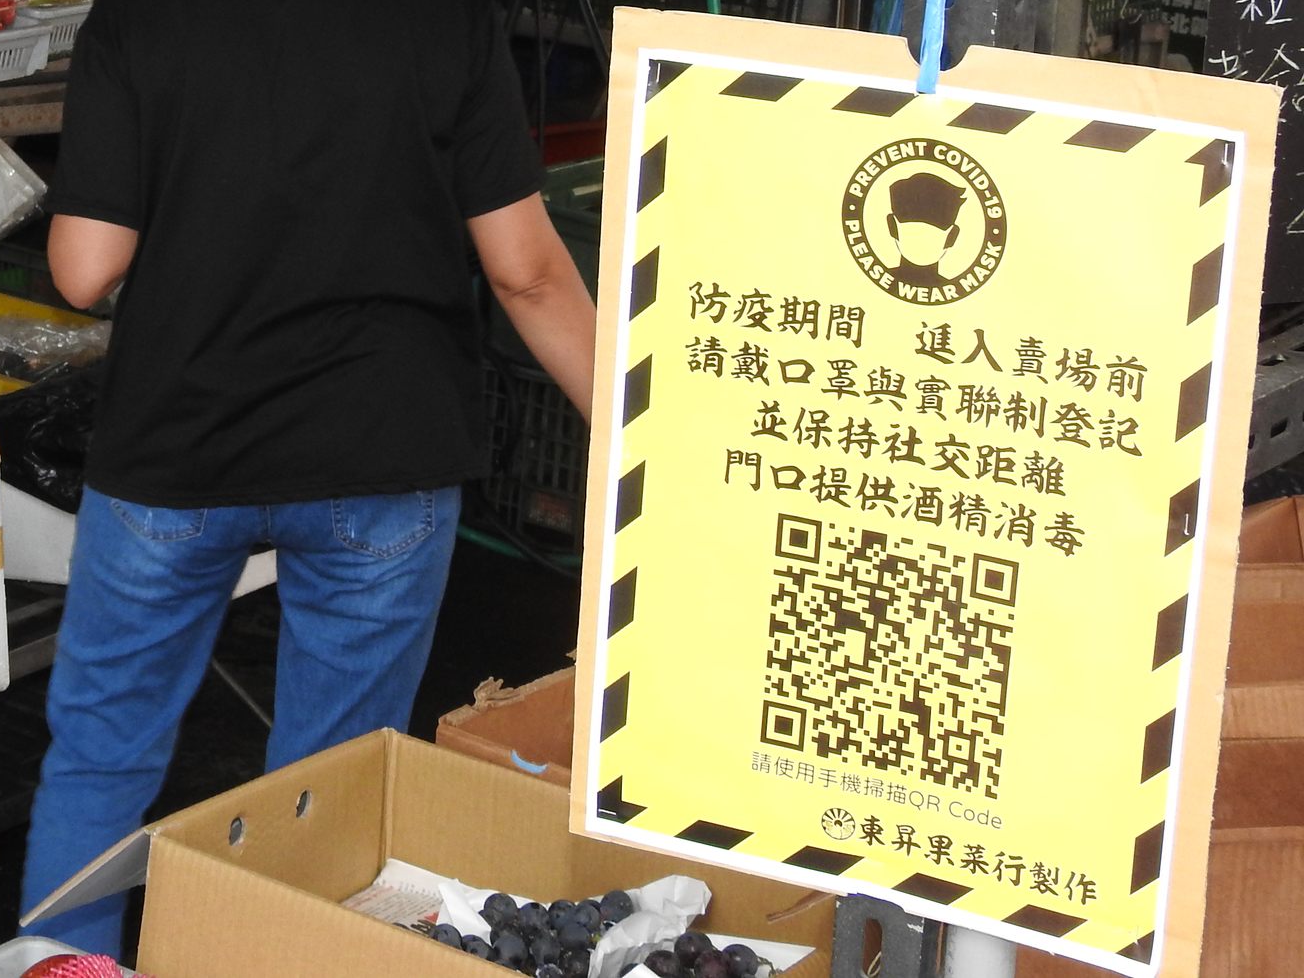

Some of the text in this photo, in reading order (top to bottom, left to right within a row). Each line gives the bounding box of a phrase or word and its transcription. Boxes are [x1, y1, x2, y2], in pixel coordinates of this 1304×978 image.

[848, 141, 1003, 219] PREVENT COVID-19
[845, 219, 1003, 303] PLEASE WEAR MASK
[688, 281, 1148, 403] 防疫期間 進入賣場前
[685, 335, 1143, 457] 請戴口罩與實聯制登記
[750, 399, 1067, 498] 並保持社交距離
[723, 448, 1086, 557] 門口提供酒精消毒
[751, 751, 1003, 830] 請使用手機掃描QR Code
[859, 815, 1098, 906] 東昇果菜行製作
